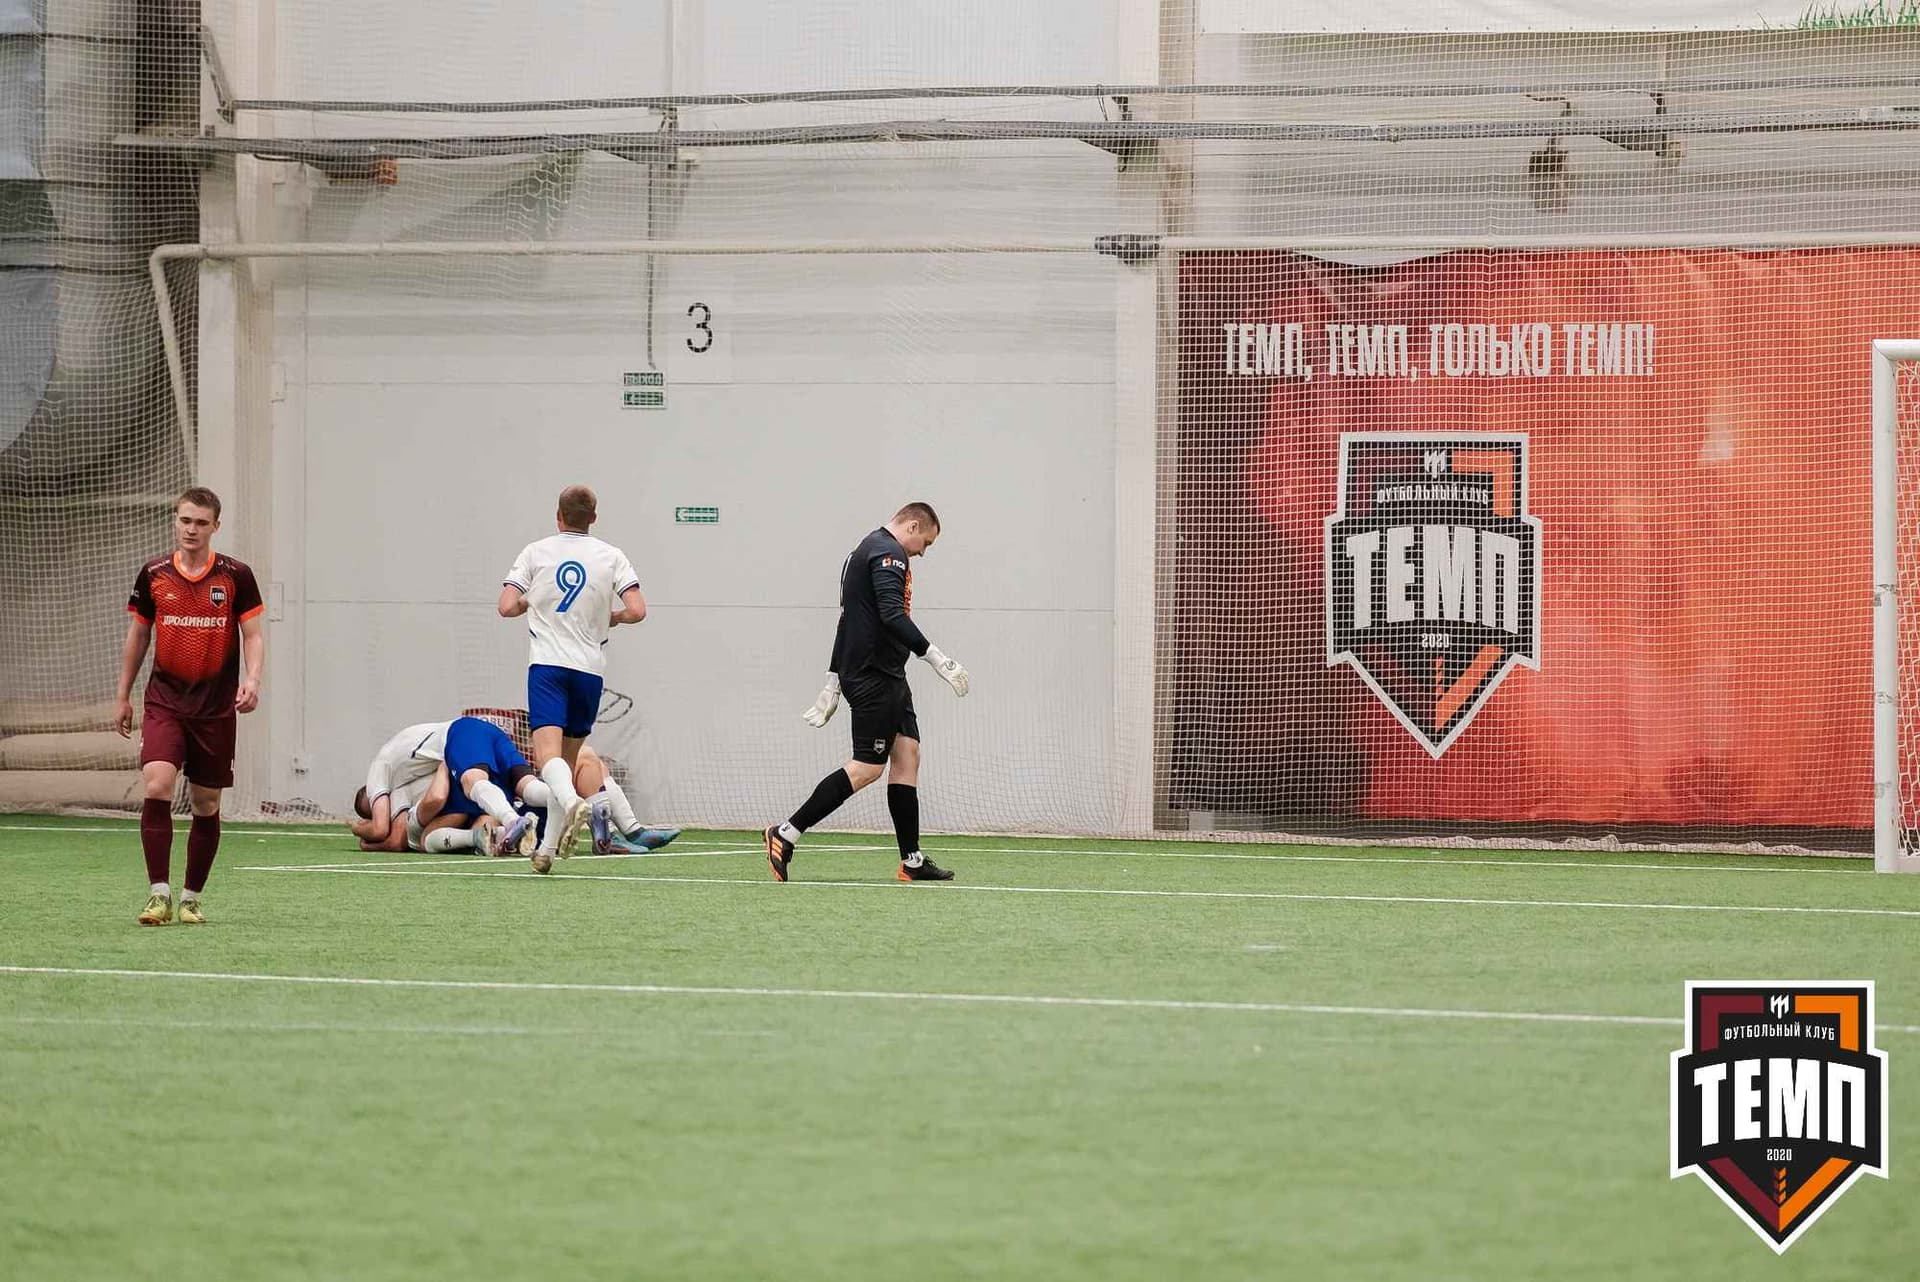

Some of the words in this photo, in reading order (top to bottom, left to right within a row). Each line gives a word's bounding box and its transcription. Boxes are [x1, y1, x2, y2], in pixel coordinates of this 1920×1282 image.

[686, 302, 713, 353] 3
[1224, 322, 1313, 382] ТЕМП,
[1325, 323, 1418, 383] ТЕМП,
[1430, 322, 1551, 377] ТОЛЬКО
[1562, 323, 1654, 377] ТЕМП!
[1376, 482, 1458, 504] ФУТБОЛЬНЫЙ
[1462, 489, 1489, 505] КЛУБ
[555, 560, 587, 613] 9
[1346, 524, 1521, 636] ТЕМП
[1421, 633, 1450, 648] 2020
